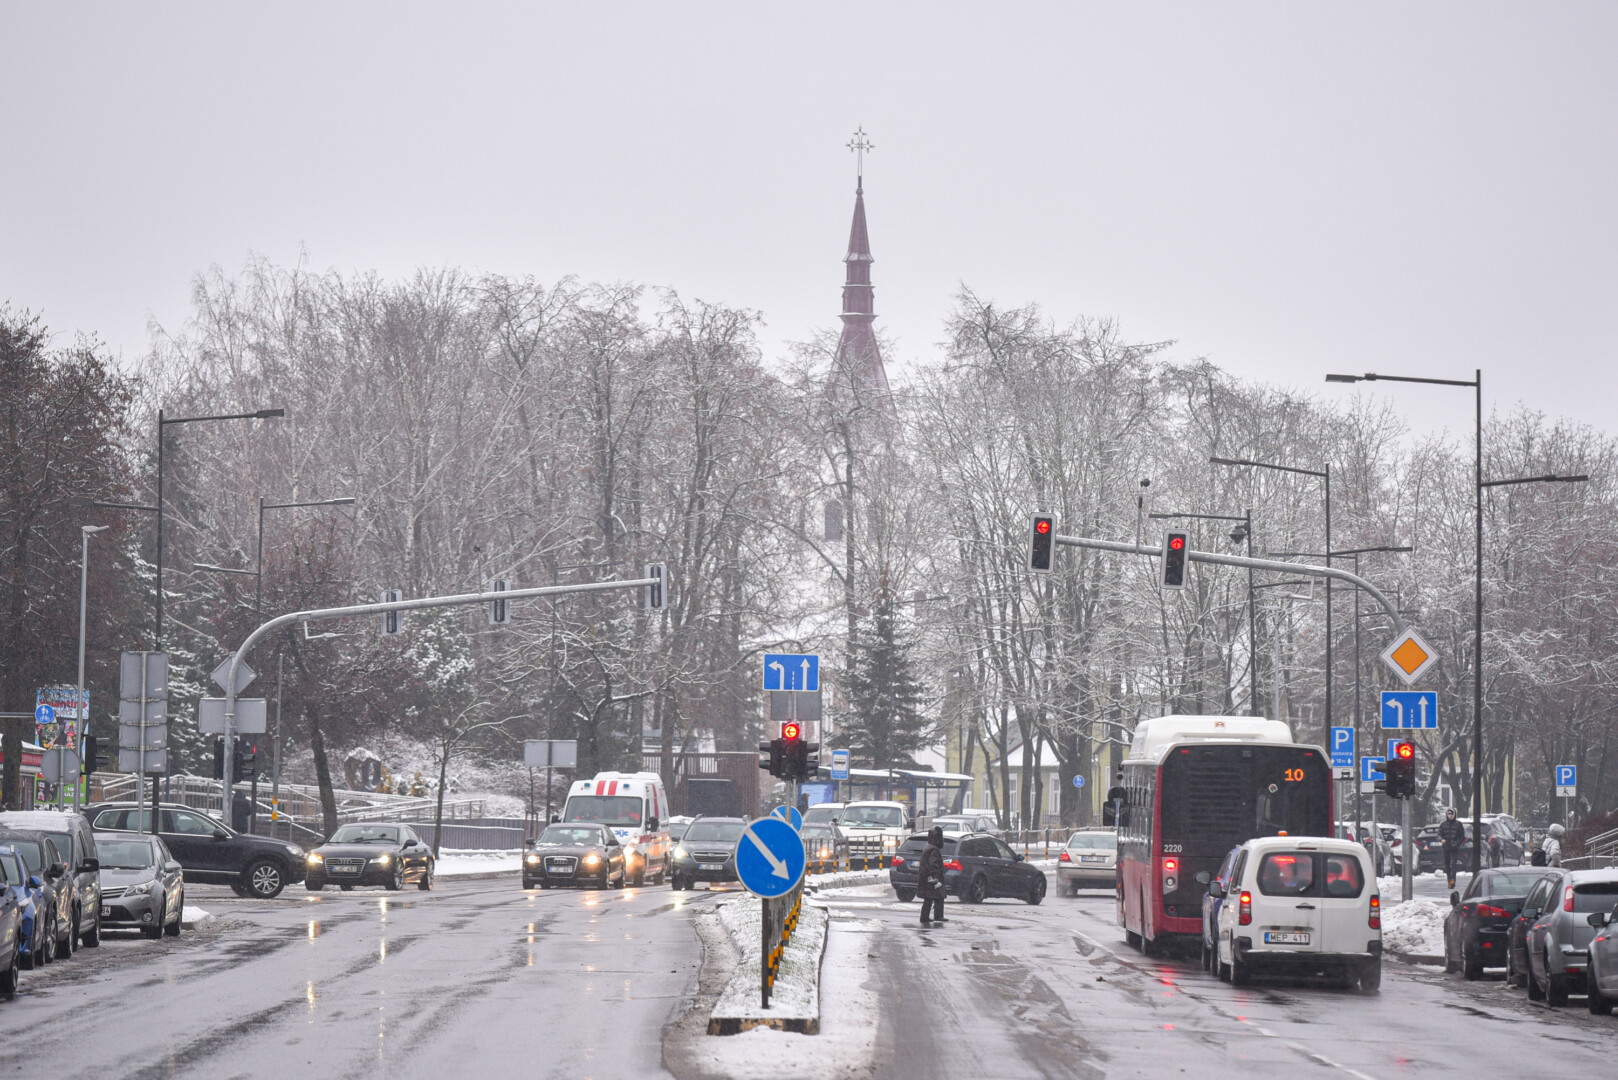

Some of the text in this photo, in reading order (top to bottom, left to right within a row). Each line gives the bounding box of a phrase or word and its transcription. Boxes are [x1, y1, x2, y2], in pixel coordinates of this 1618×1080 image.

[1335, 729, 1350, 750] P
[1284, 767, 1305, 782] 10
[1562, 768, 1573, 784] P
[1164, 844, 1183, 853] 2220
[1270, 934, 1308, 943] MEP 411
